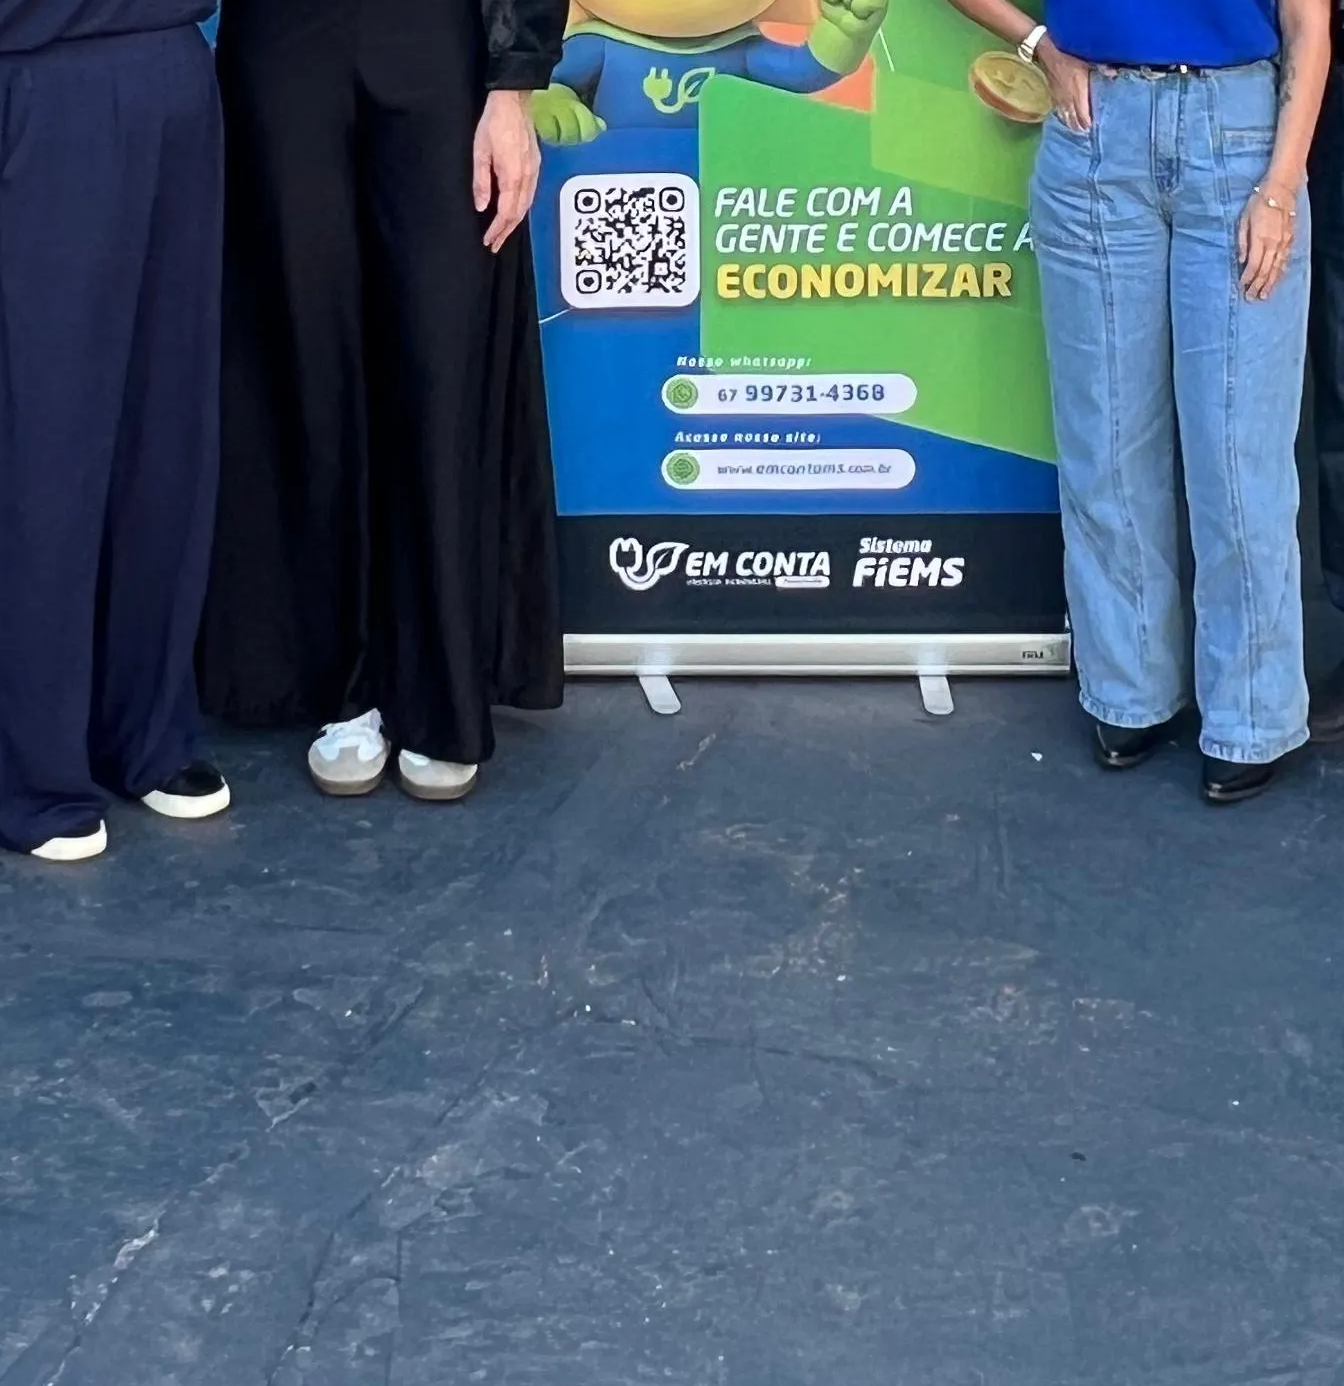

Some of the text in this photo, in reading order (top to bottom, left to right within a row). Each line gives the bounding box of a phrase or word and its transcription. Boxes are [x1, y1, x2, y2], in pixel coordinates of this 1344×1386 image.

[714, 186, 915, 218] FALE COM A
[715, 221, 1037, 254] GENTE E COMECE A
[715, 262, 1014, 299] ECONOMIZAR
[717, 384, 885, 403] 67 99731-4368
[859, 537, 933, 554] Sistema
[685, 551, 831, 577] EM CONTA
